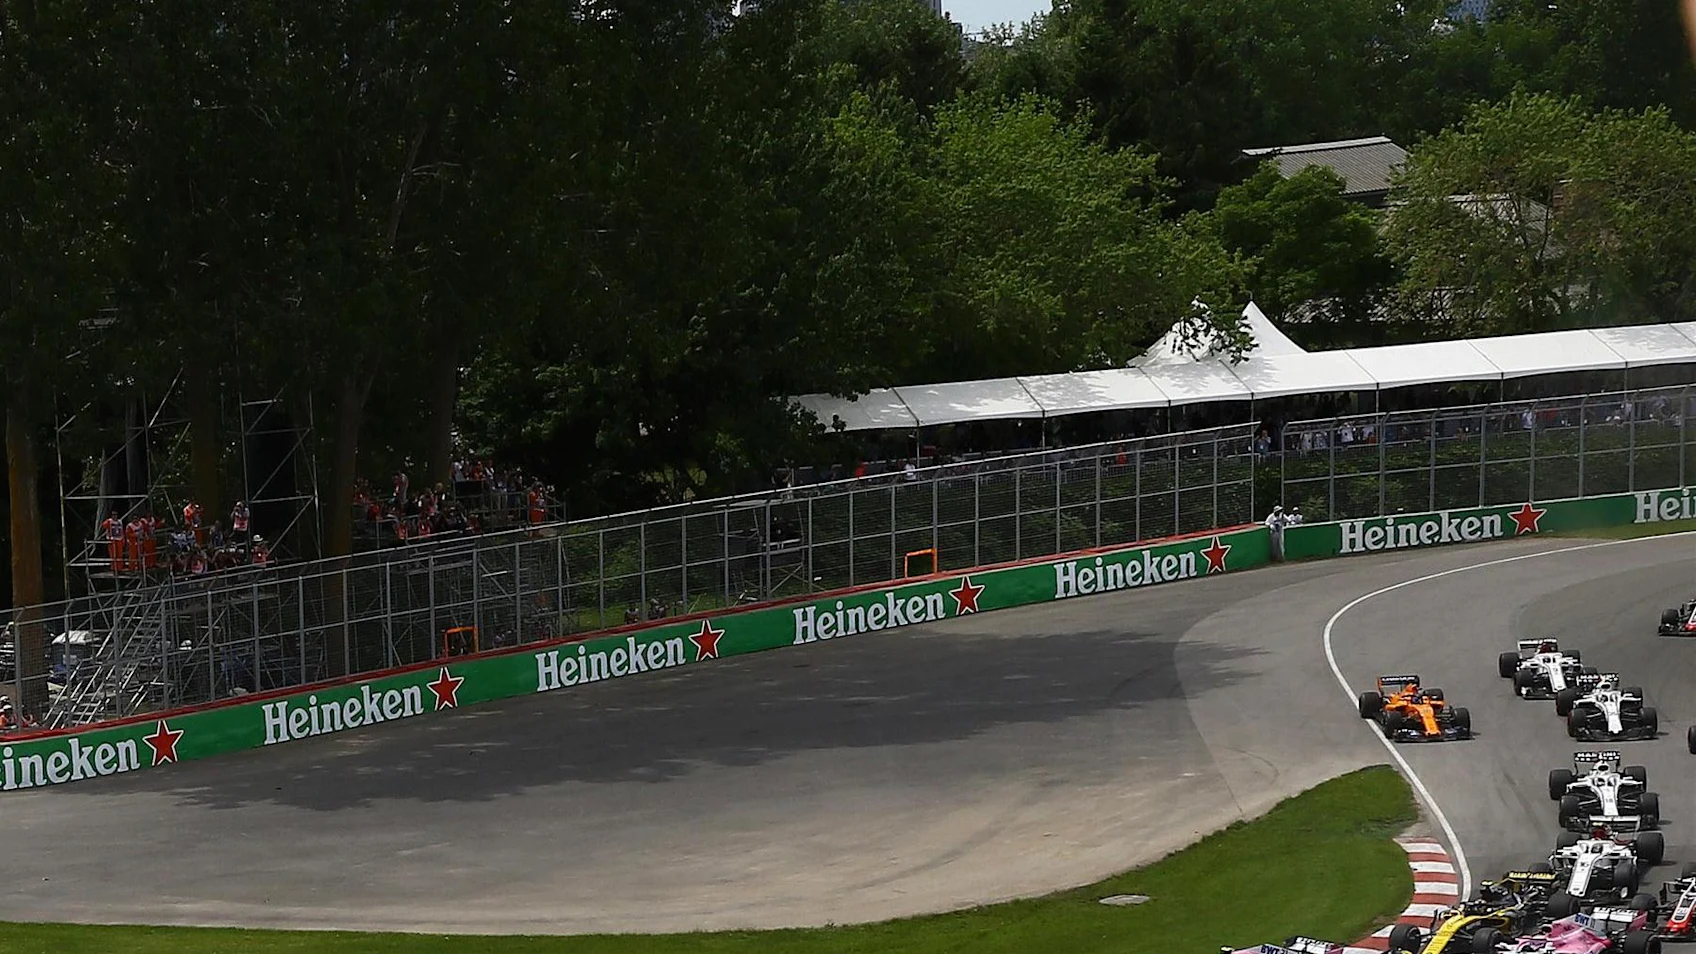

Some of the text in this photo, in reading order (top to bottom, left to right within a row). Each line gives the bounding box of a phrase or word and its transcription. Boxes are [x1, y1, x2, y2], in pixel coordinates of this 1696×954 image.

[1634, 489, 1696, 523] Hei
[1339, 512, 1503, 554] Heineken
[1054, 550, 1197, 598] Heineken
[793, 592, 946, 645] Heineken
[535, 637, 686, 692] Heineken
[262, 685, 424, 745] Heineken
